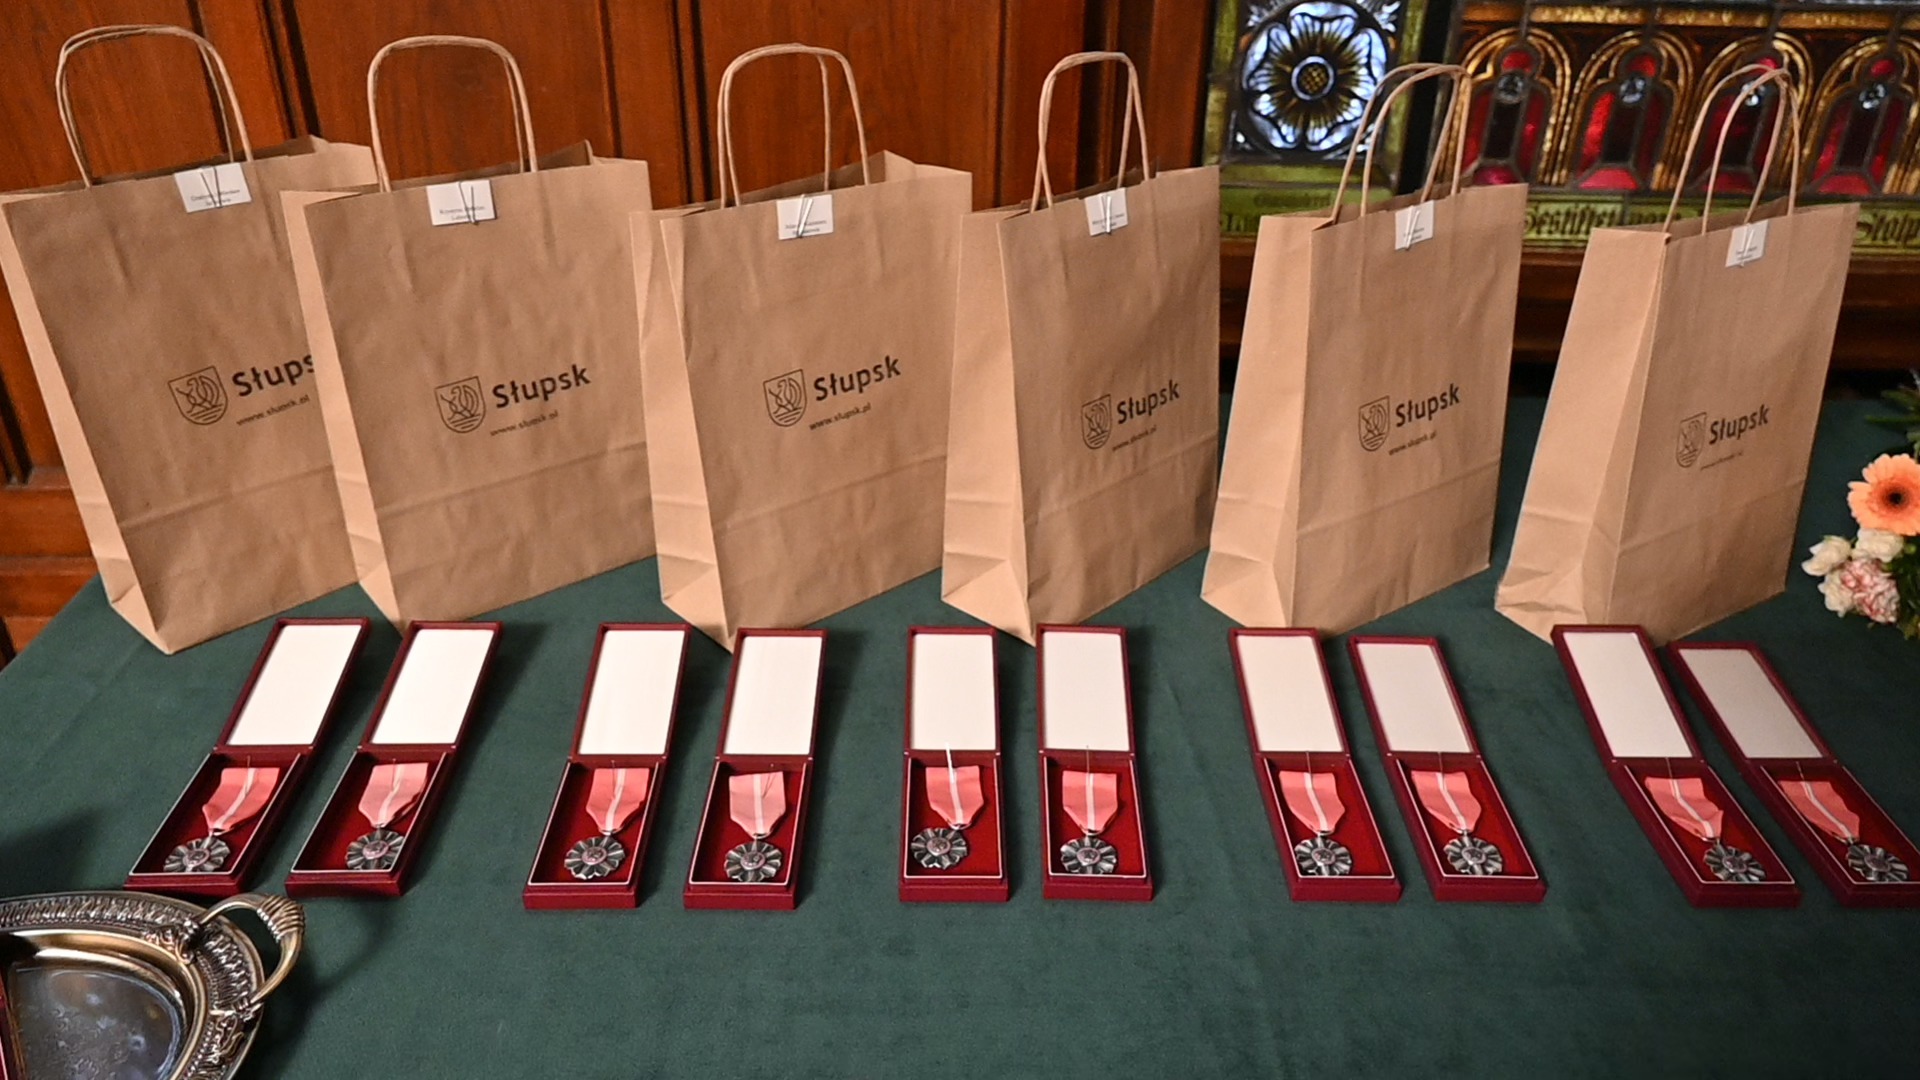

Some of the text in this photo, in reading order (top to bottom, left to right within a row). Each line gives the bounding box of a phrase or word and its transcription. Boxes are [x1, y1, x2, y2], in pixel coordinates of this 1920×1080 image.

[232, 354, 314, 397] Słups
[492, 364, 590, 408] Słupsk
[814, 355, 901, 401] Słupsk
[1117, 379, 1179, 424] Słupsk
[1396, 383, 1459, 427] Słupsk
